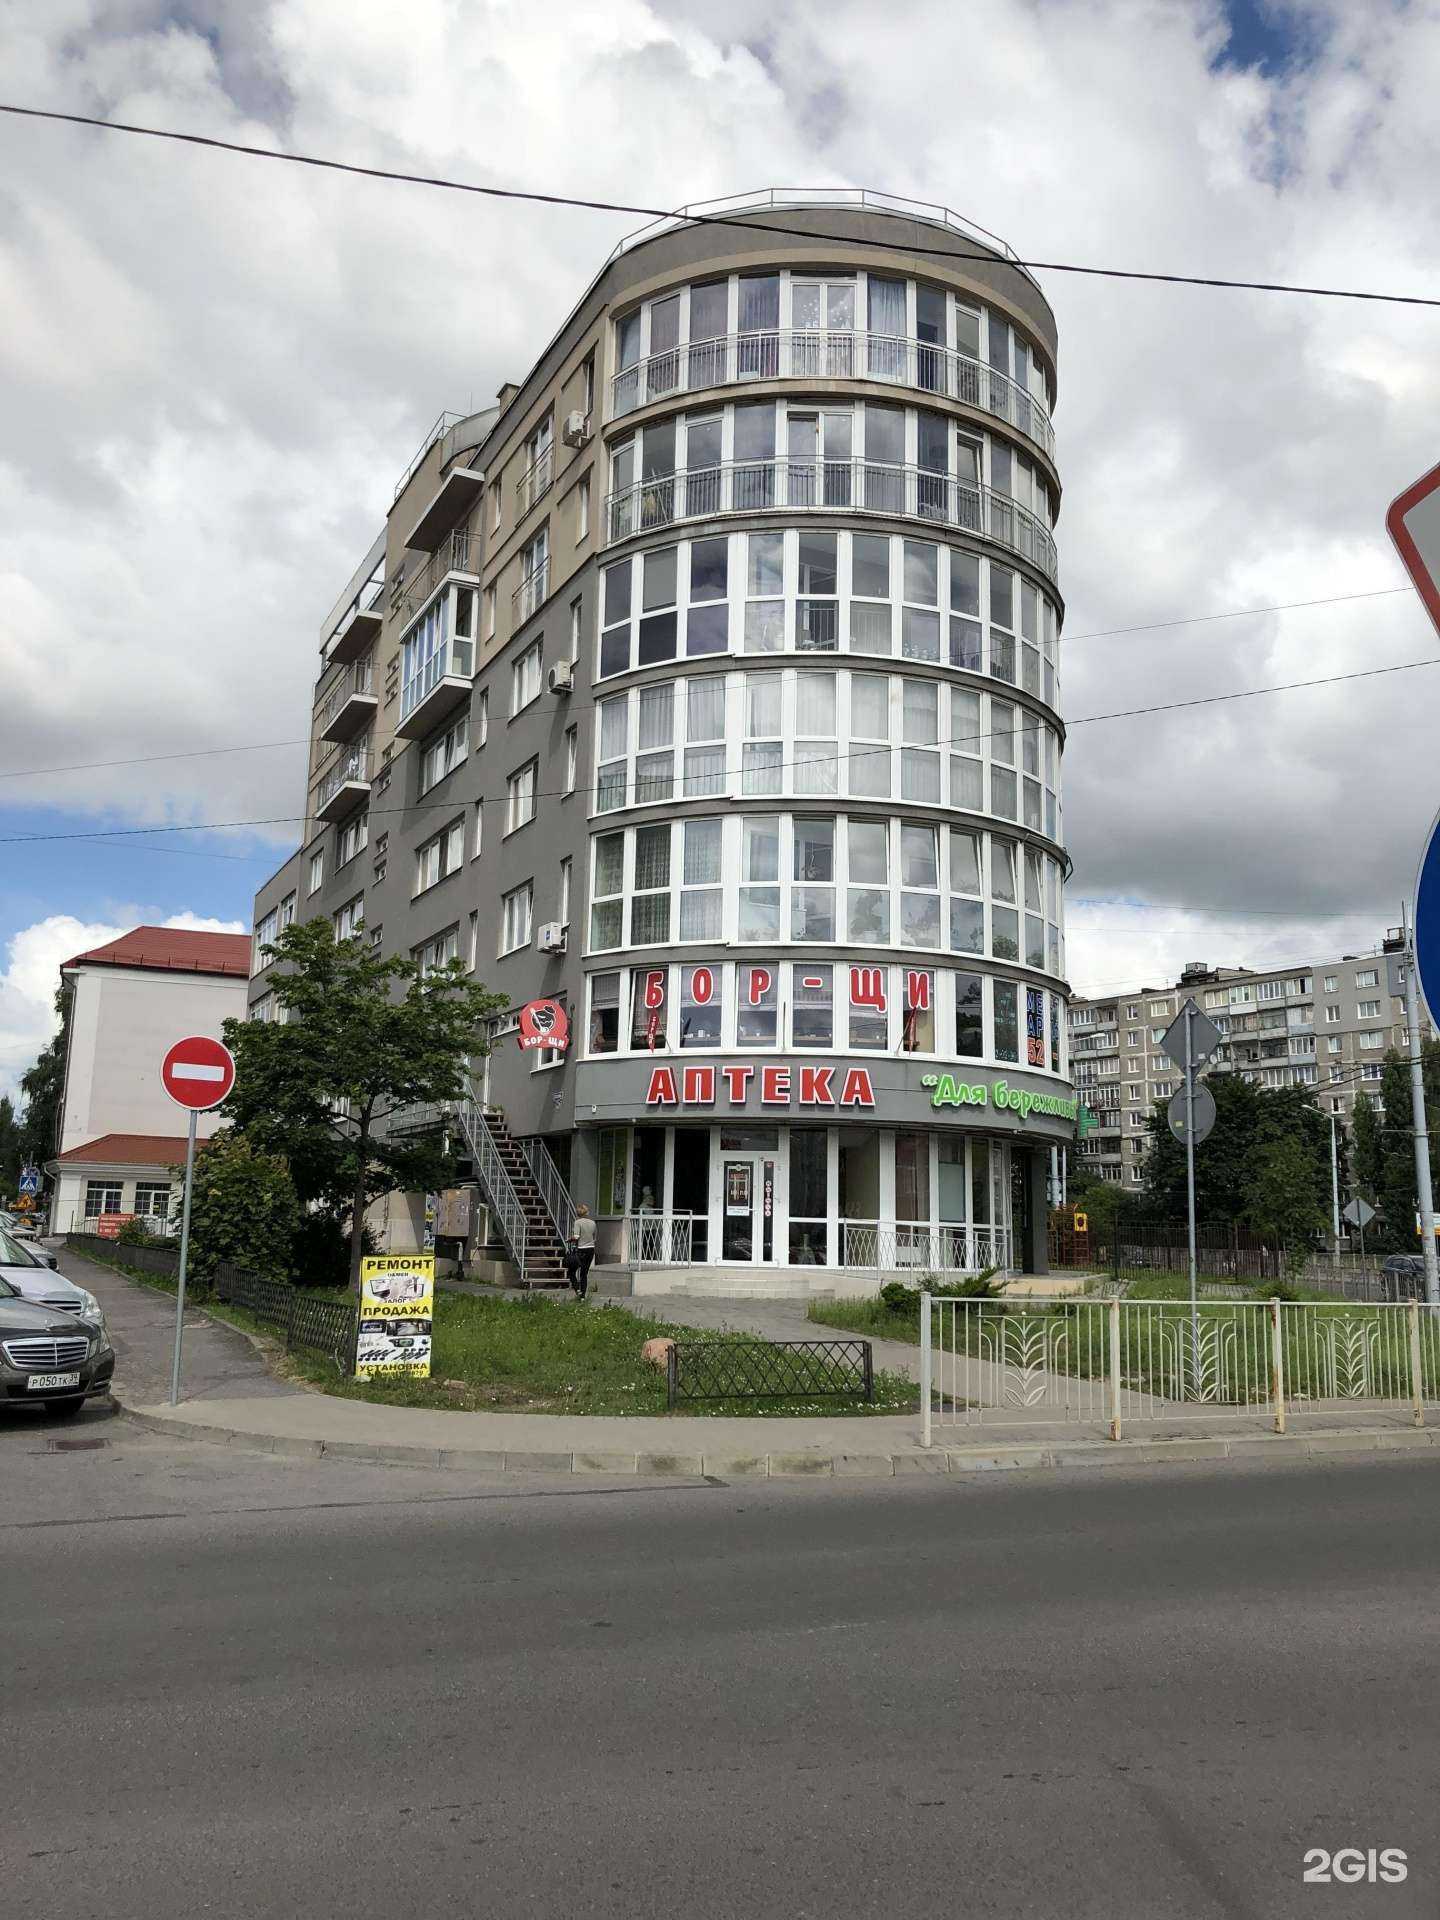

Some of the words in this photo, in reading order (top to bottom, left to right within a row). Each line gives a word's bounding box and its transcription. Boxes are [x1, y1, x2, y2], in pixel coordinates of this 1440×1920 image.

[645, 966, 929, 1013] БОР-ЩИ
[524, 1035, 565, 1048] БОР-ЩИ
[645, 1066, 876, 1106] АПТЕКА
[366, 1259, 433, 1270] РЕМОНТ
[363, 1305, 430, 1317] ПРОДАЖА
[359, 1362, 428, 1372] УСТАНОВКА
